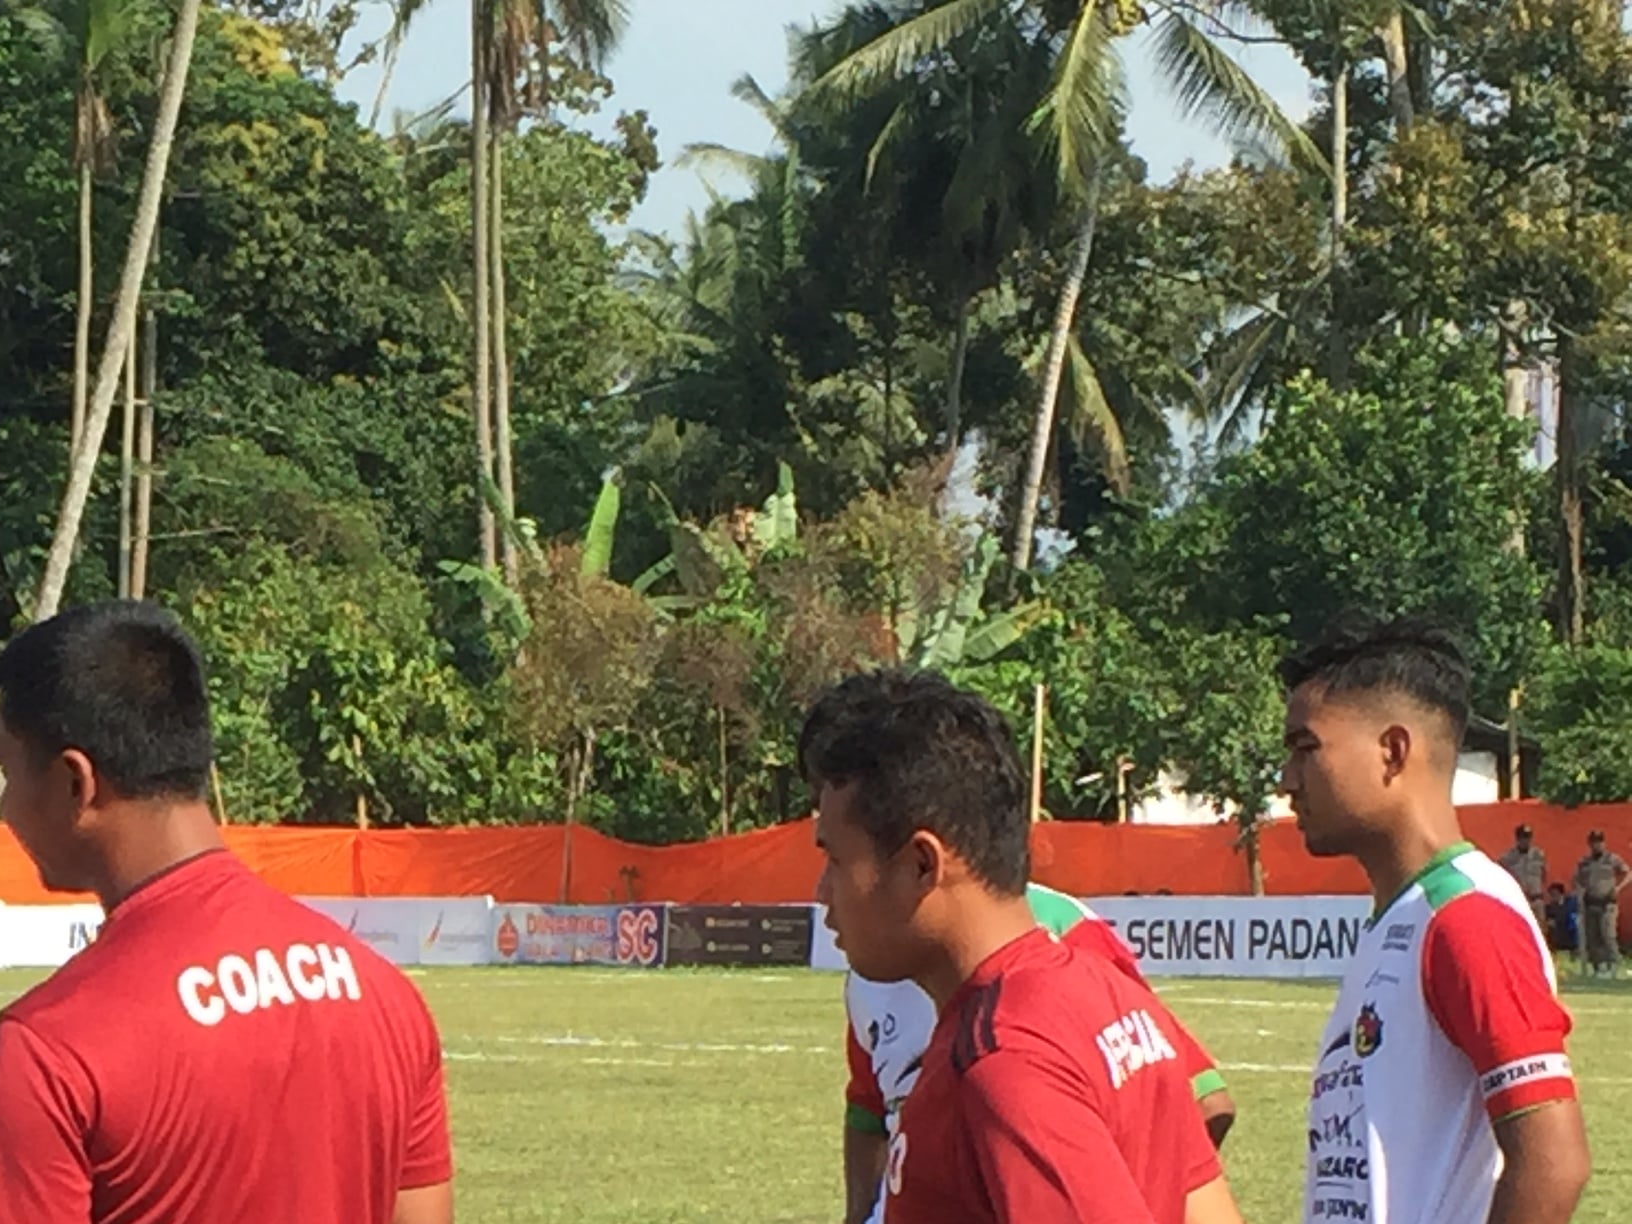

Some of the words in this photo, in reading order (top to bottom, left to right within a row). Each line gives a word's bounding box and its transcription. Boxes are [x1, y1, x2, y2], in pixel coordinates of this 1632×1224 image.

[617, 908, 658, 965] SC
[1127, 918, 1235, 961] SEMEN
[1248, 917, 1373, 961] PADAN
[177, 942, 362, 1026] COACH
